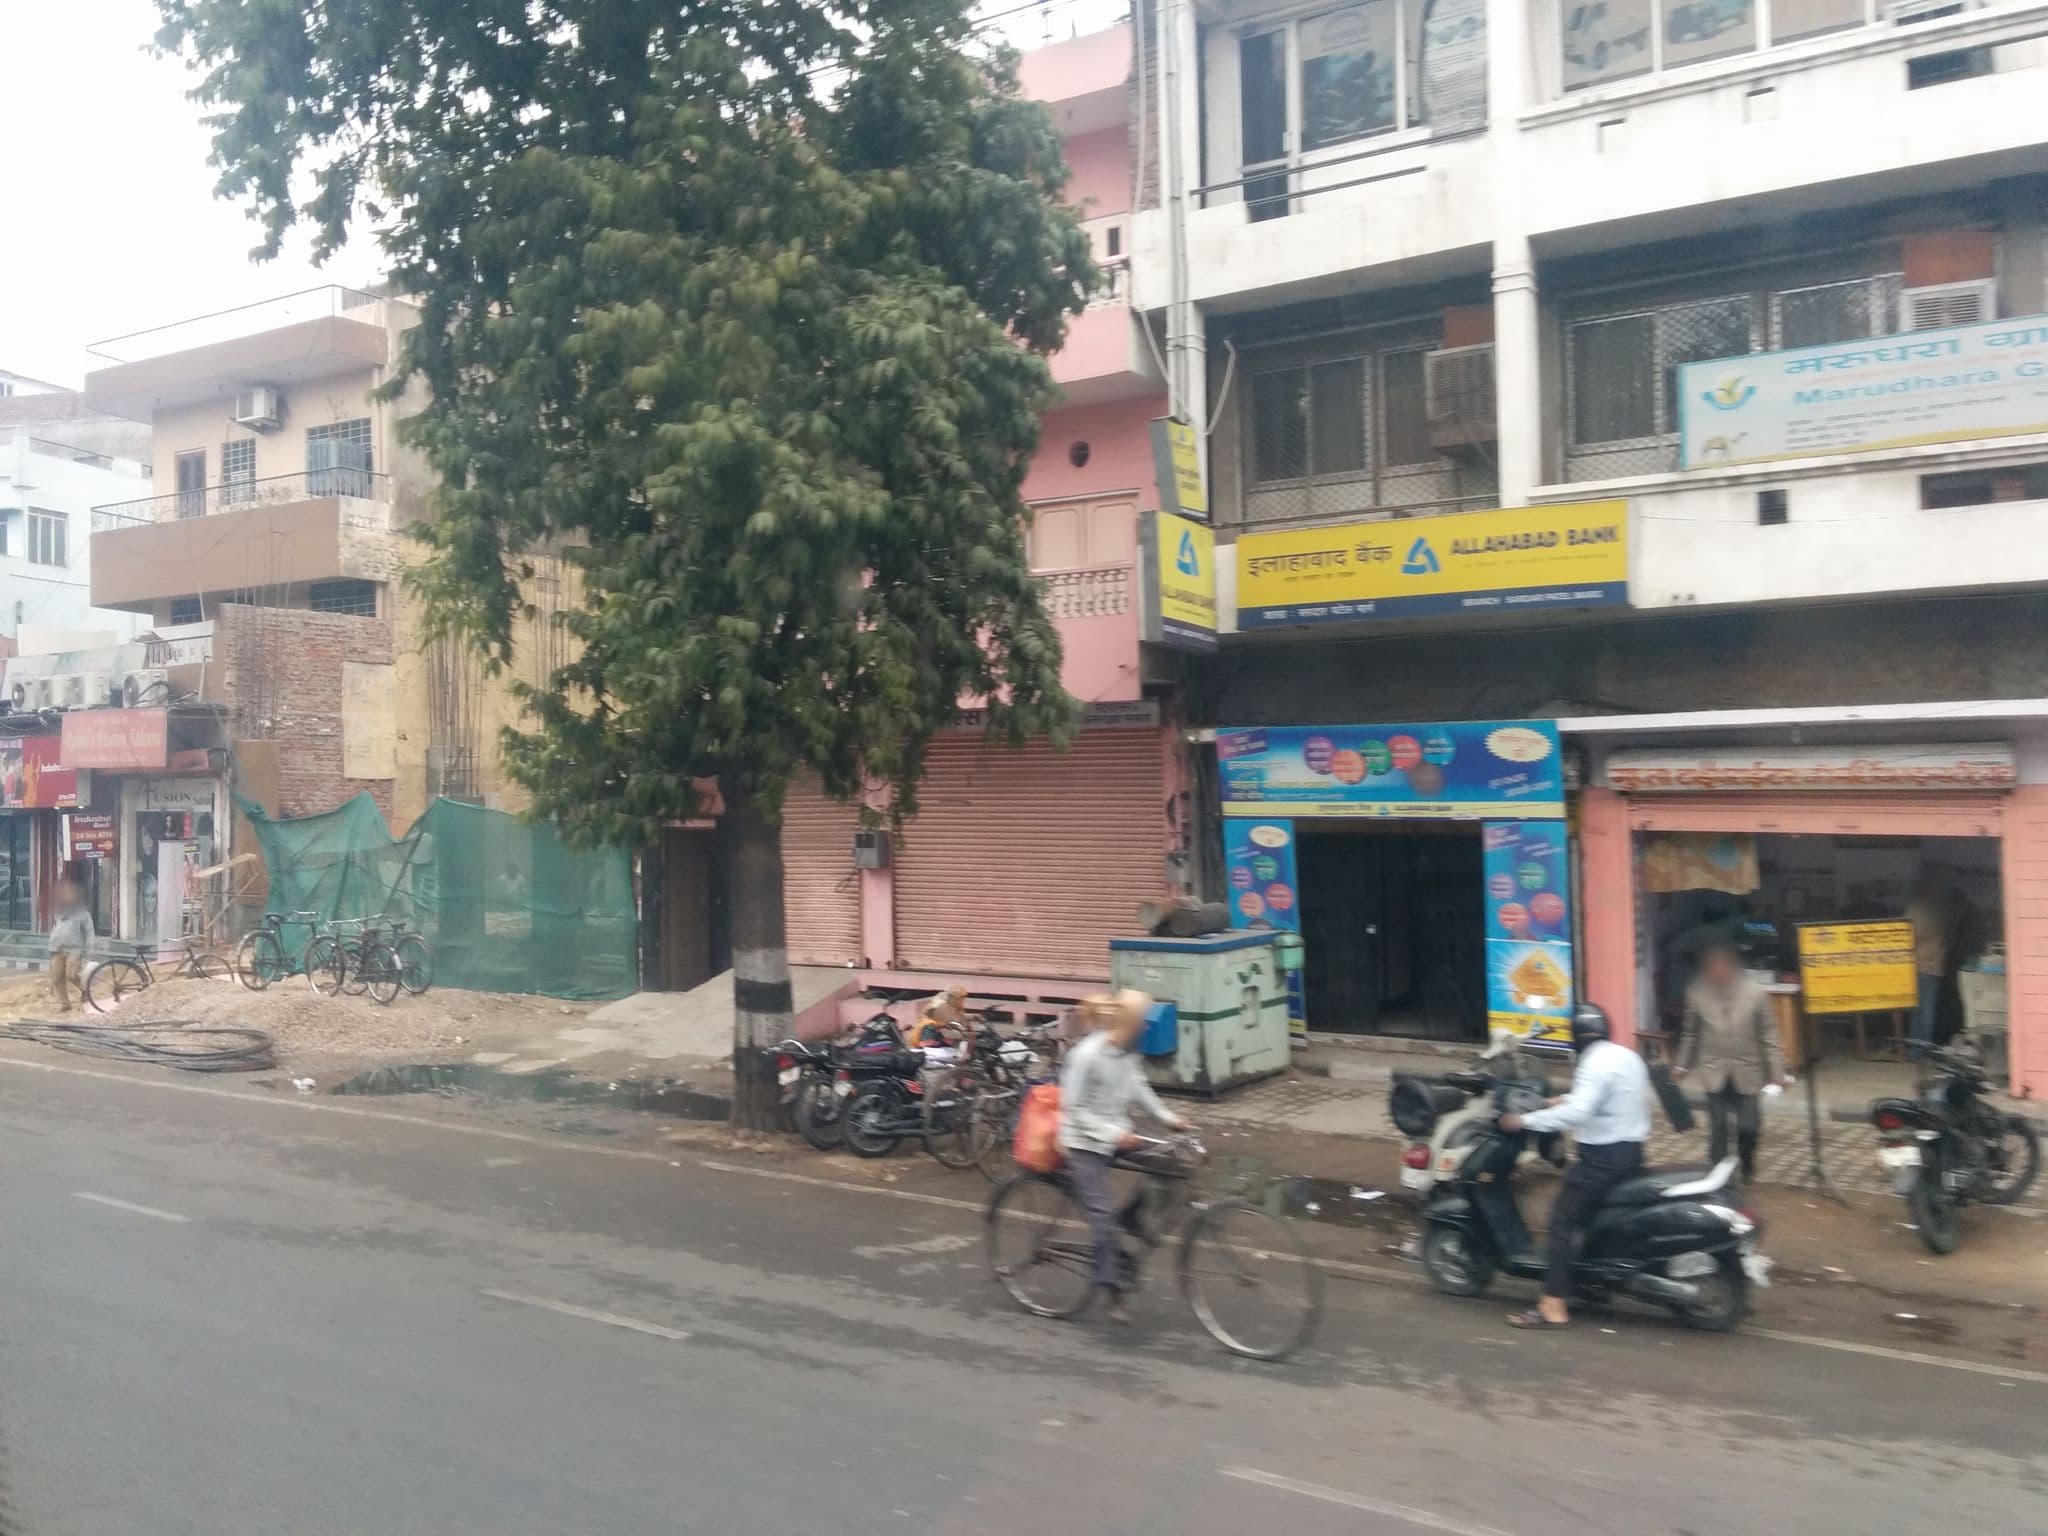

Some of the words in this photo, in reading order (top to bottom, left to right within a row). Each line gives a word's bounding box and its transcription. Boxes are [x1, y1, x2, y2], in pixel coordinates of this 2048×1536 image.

[1785, 339, 1962, 374] मरुधरा
[1792, 369, 2000, 404] Marudhara
[1451, 530, 1559, 555] ALLAHABAD
[1565, 525, 1619, 546] BANK
[1247, 549, 1348, 577] इलाहाबाद
[1355, 540, 1393, 563] बैंक
